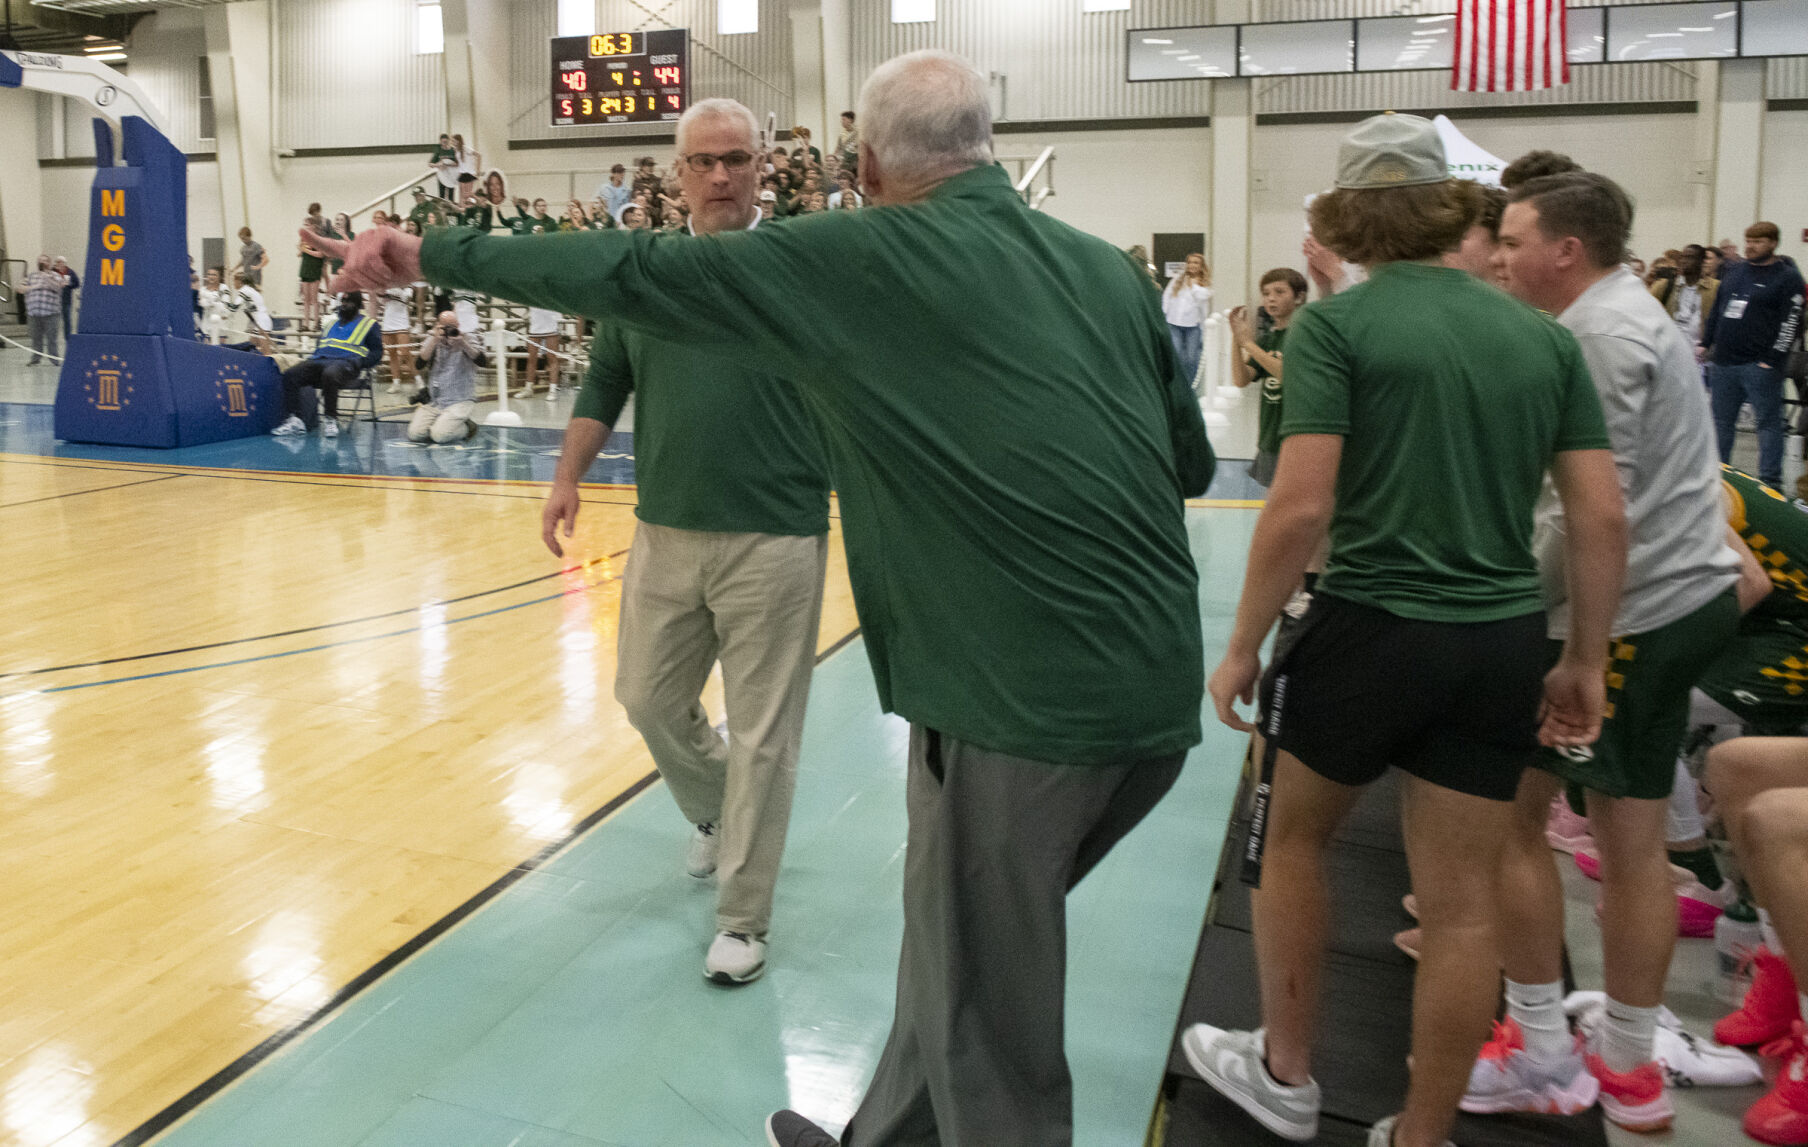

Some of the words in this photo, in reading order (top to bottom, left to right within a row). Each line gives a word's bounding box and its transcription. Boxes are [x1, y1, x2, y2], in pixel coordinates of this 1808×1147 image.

[559, 60, 584, 70] HOME
[650, 54, 678, 65] GUEST
[562, 72, 586, 90] 40
[611, 72, 623, 86] 4
[654, 66, 680, 85] 44
[582, 98, 593, 115] 3
[667, 95, 680, 109] 4
